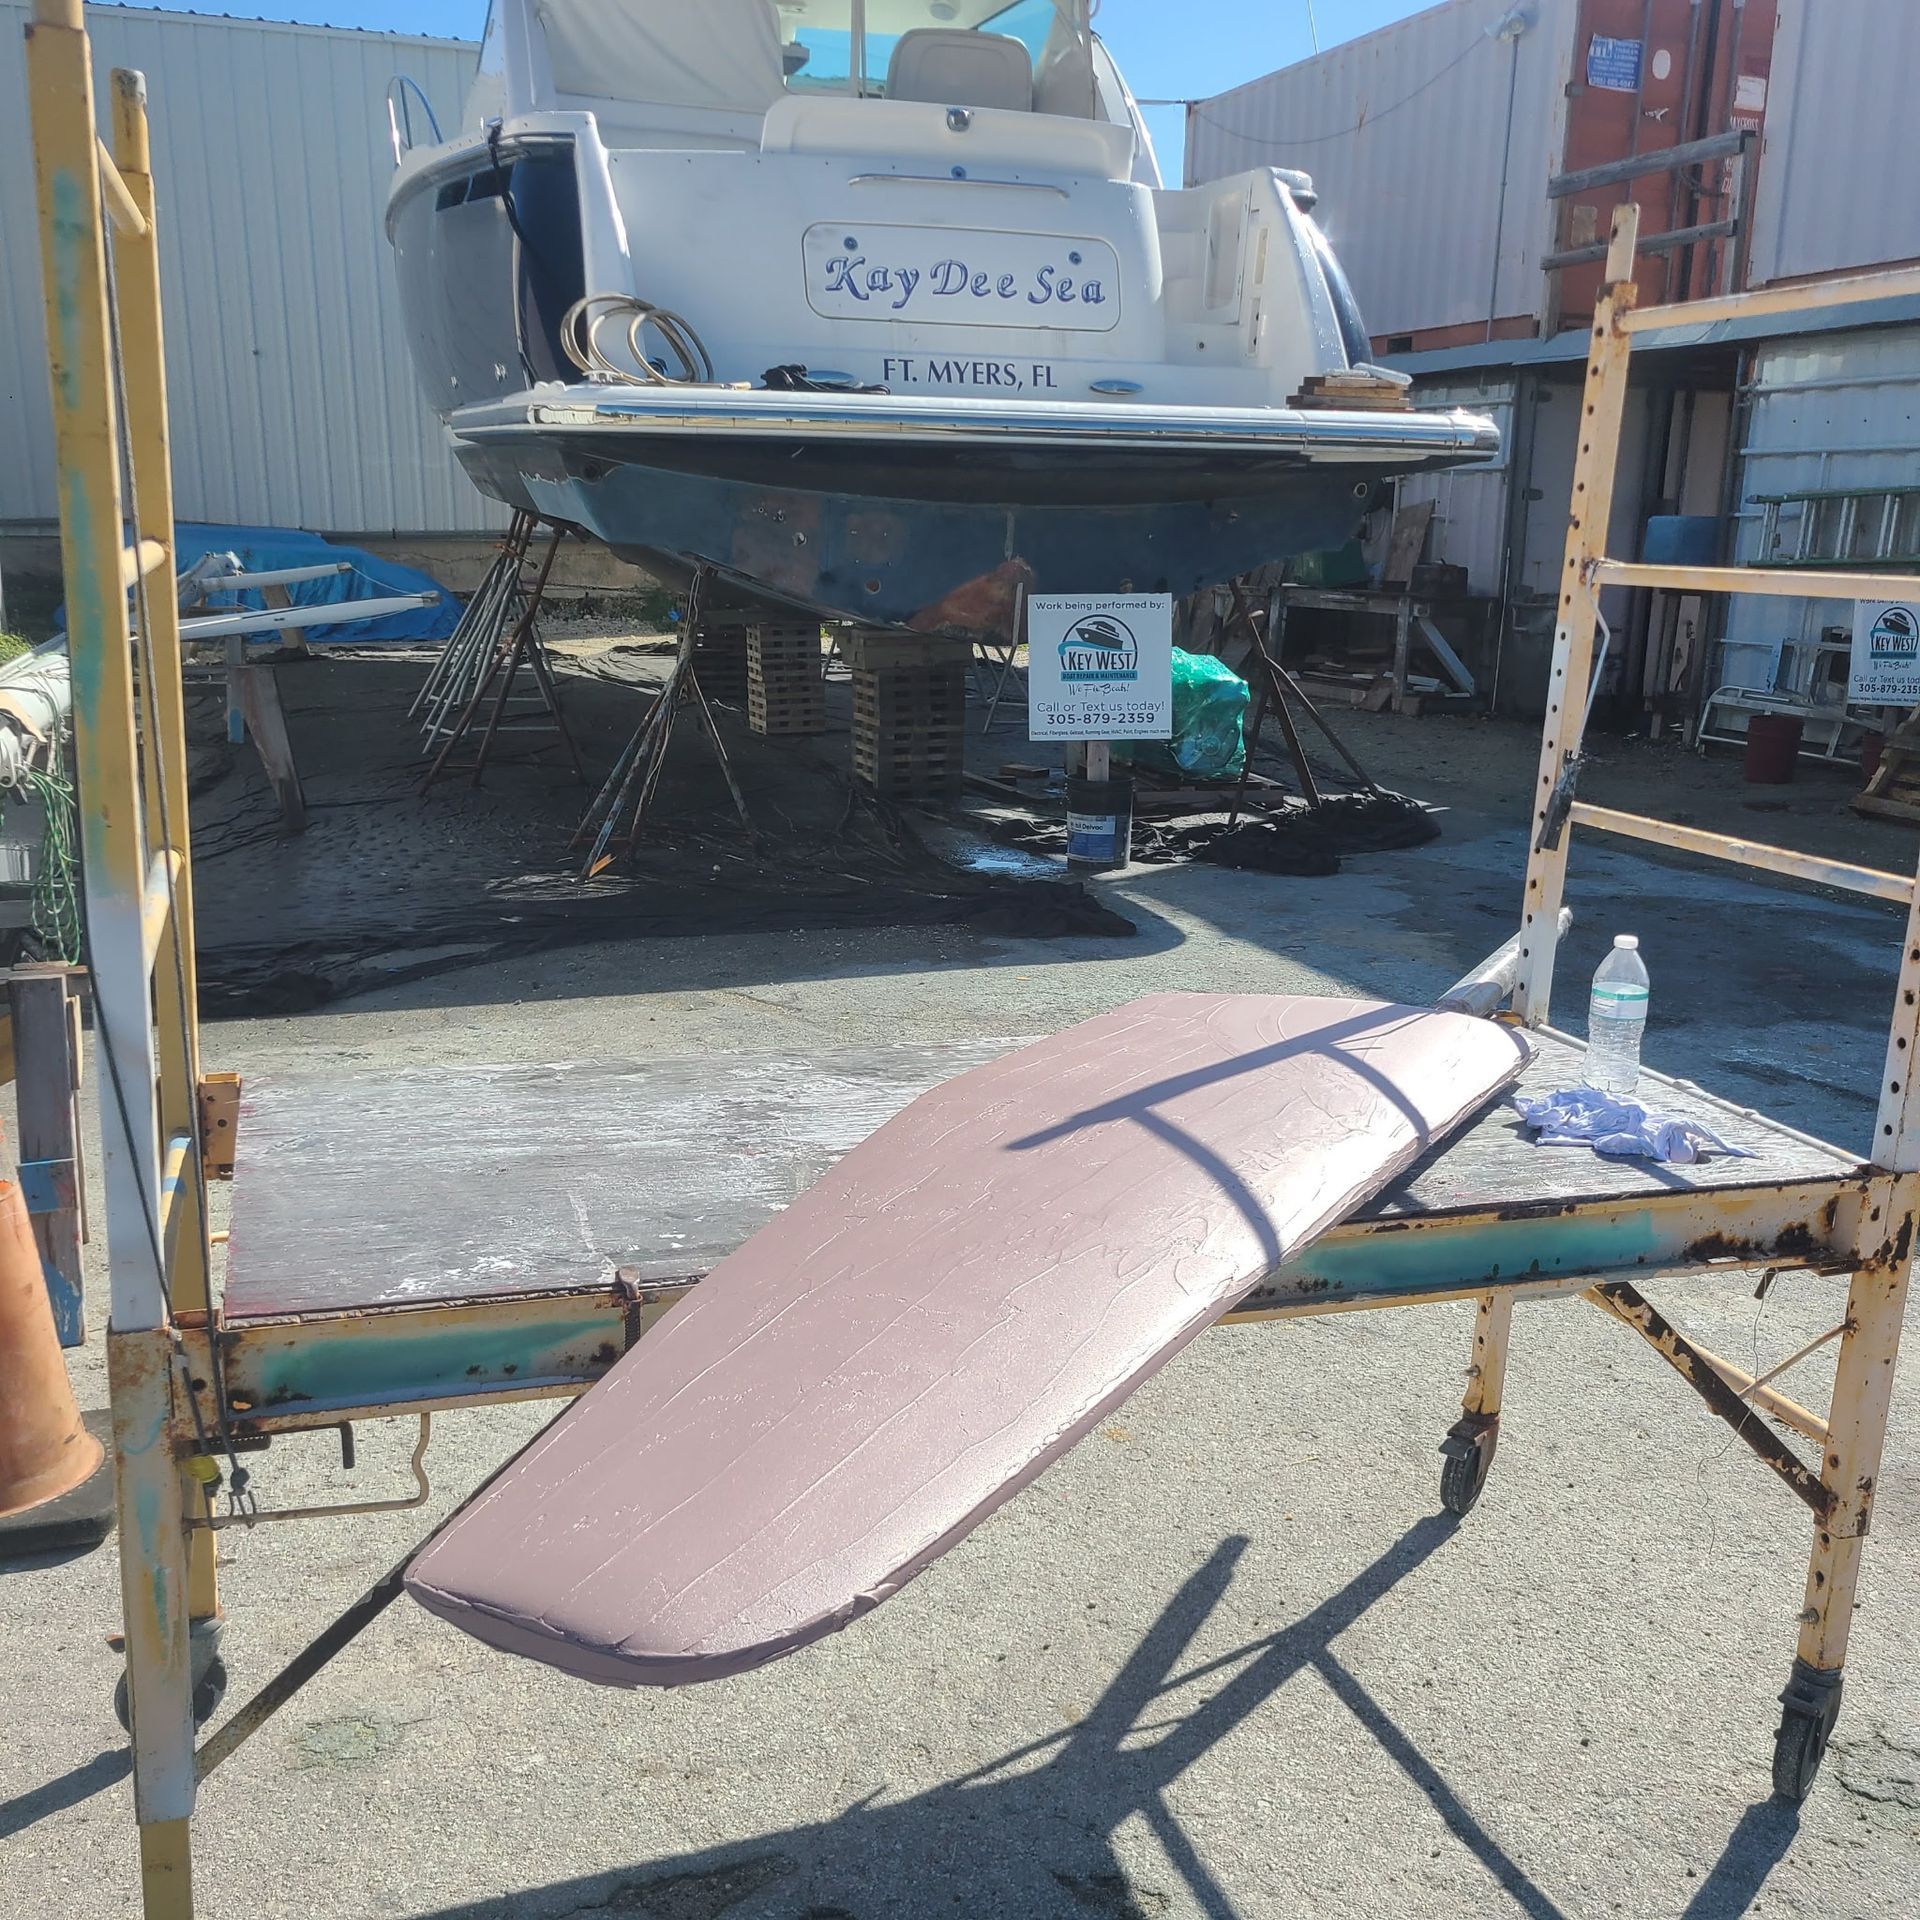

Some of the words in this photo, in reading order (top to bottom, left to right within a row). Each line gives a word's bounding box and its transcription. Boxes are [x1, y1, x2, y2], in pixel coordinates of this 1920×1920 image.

[825, 256, 920, 309] Kay
[929, 259, 1018, 299] Dee
[1027, 265, 1107, 305] Sea
[883, 358, 918, 382] FT.
[927, 361, 1024, 392] MYERS,
[1032, 365, 1058, 388] FL
[1036, 602, 1062, 610] Work
[1065, 601, 1092, 611] being
[1095, 601, 1147, 611] performed
[1150, 600, 1165, 609] by:
[1875, 635, 1891, 651] KEY
[1892, 635, 1915, 651] WEST
[1068, 651, 1092, 671] KEY
[1096, 651, 1132, 670] WEST
[1077, 671, 1095, 679] REPAIR
[1101, 671, 1136, 679] MAINTENANCE
[1853, 674, 1868, 683] Call
[1880, 675, 1895, 684] Text
[1897, 676, 1906, 684] us
[1037, 702, 1060, 712] Call
[1063, 703, 1076, 712] or
[1080, 702, 1105, 711] Text
[1109, 703, 1123, 711] us
[1127, 701, 1165, 713] today!
[1047, 713, 1155, 725] 305-879-2359
[1082, 823, 1104, 831] Delvac
